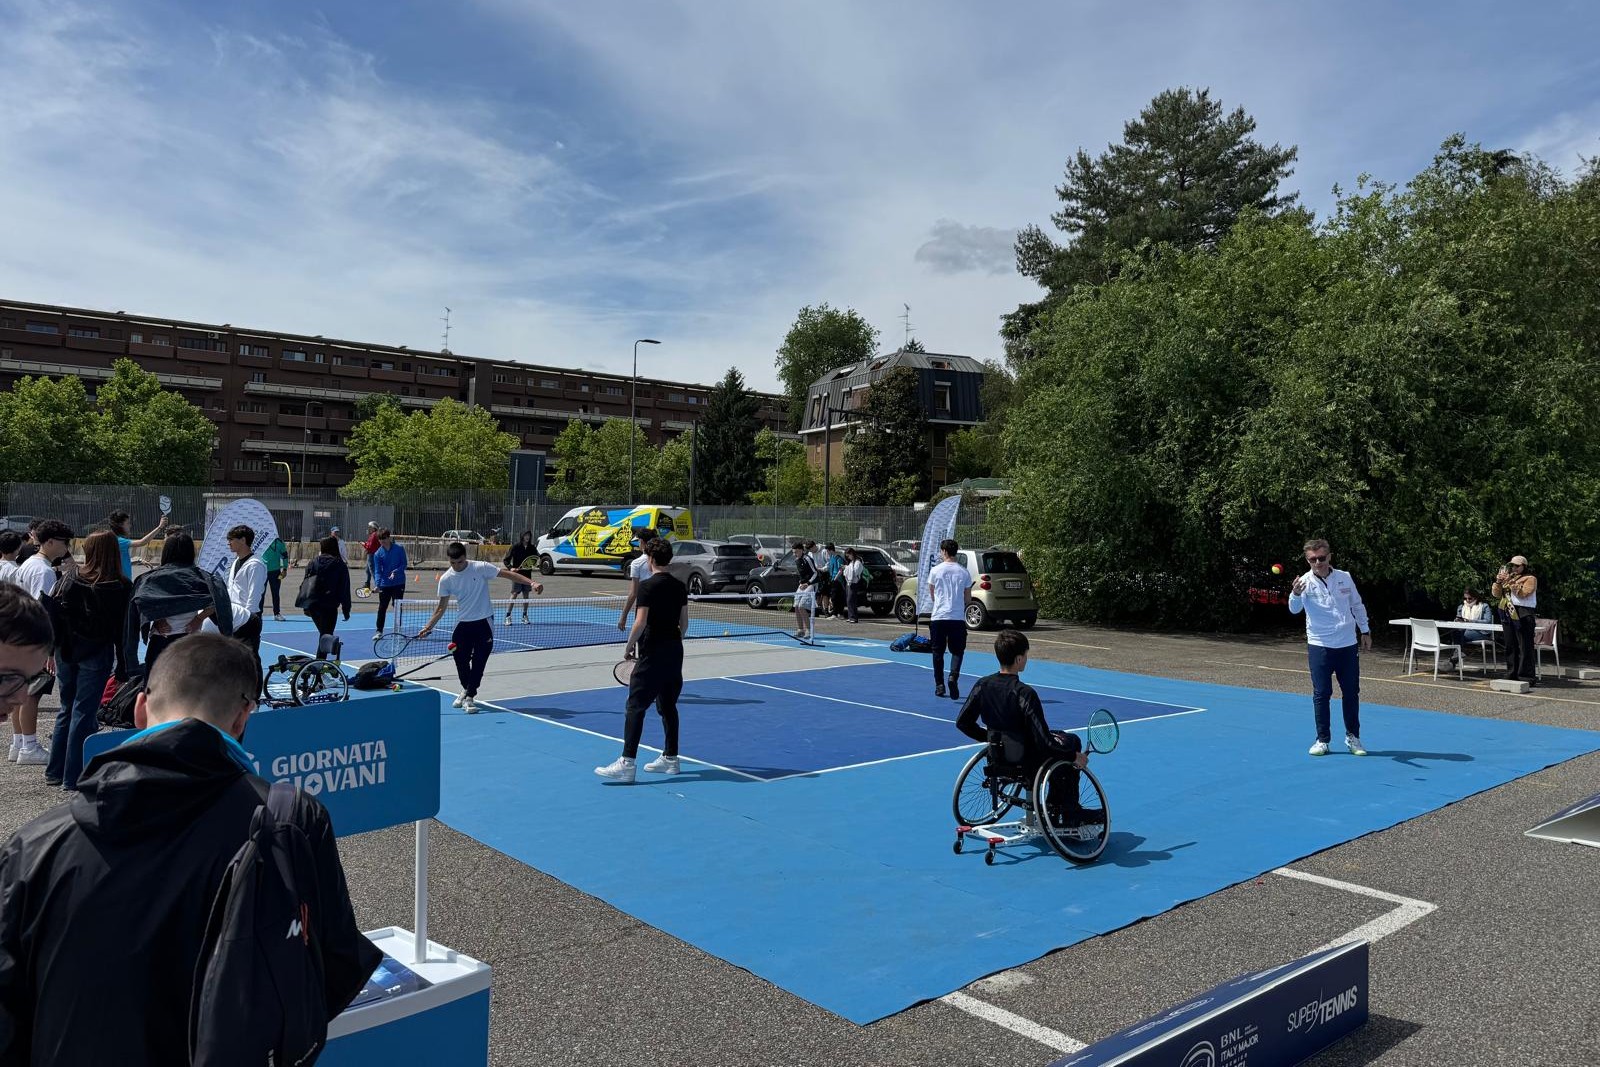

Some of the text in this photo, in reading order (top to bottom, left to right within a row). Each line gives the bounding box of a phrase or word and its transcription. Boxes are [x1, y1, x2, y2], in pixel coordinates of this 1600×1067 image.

[272, 740, 387, 777] GIORNATA
[275, 761, 386, 796] IOVANI
[1220, 1027, 1244, 1048] BNL
[1220, 1033, 1259, 1062] ITALY MAJOR
